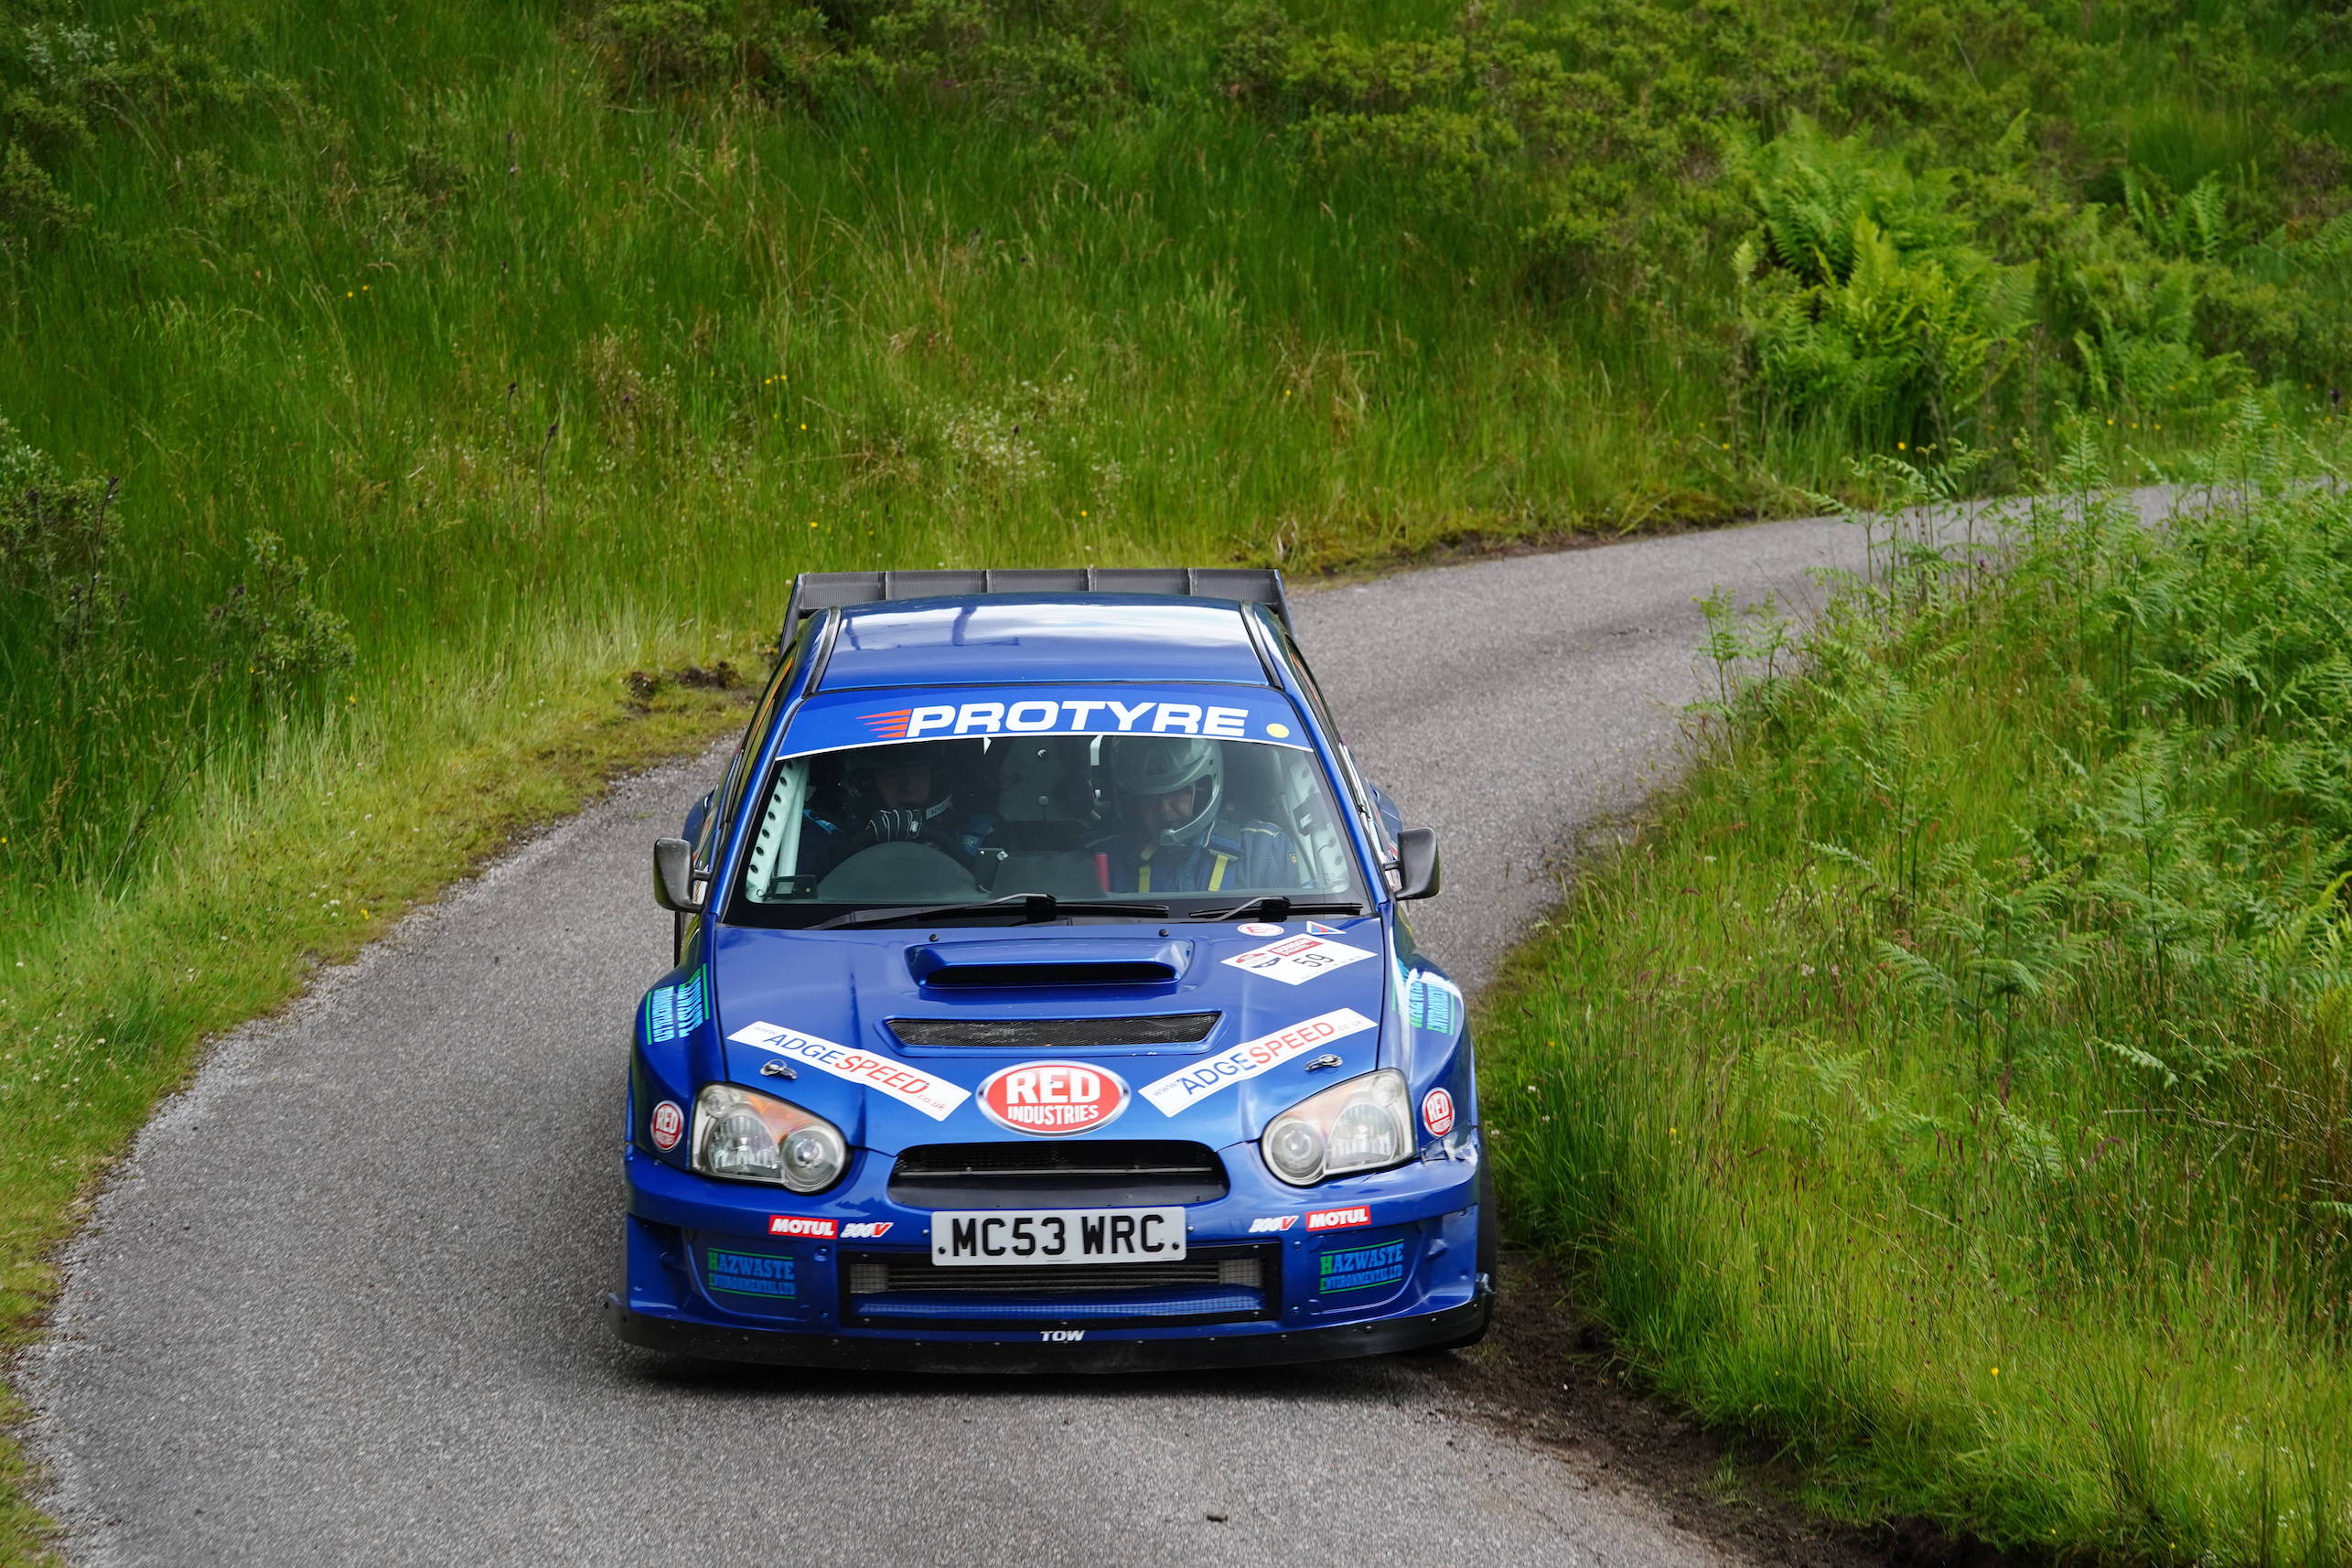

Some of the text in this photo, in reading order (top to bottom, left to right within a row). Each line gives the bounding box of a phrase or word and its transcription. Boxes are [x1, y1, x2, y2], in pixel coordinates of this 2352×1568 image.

[906, 700, 1250, 738] PROTYRE
[1292, 953, 1336, 968] 59
[763, 1033, 930, 1096] ADGESPEED
[1180, 1022, 1335, 1096] ADGESPEED
[1006, 1068, 1101, 1104] RED
[657, 1105, 679, 1134] RED
[1007, 1103, 1100, 1126] INDUSTRIES
[1426, 1094, 1450, 1123] RED
[770, 1218, 835, 1236] MOTUL
[1308, 1208, 1369, 1230] MOTUL
[951, 1214, 1165, 1257] MC53 WRC
[707, 1251, 795, 1281] HAZWASTE
[1320, 1242, 1405, 1276] HAZWASTE
[1039, 1329, 1087, 1342] TOW
